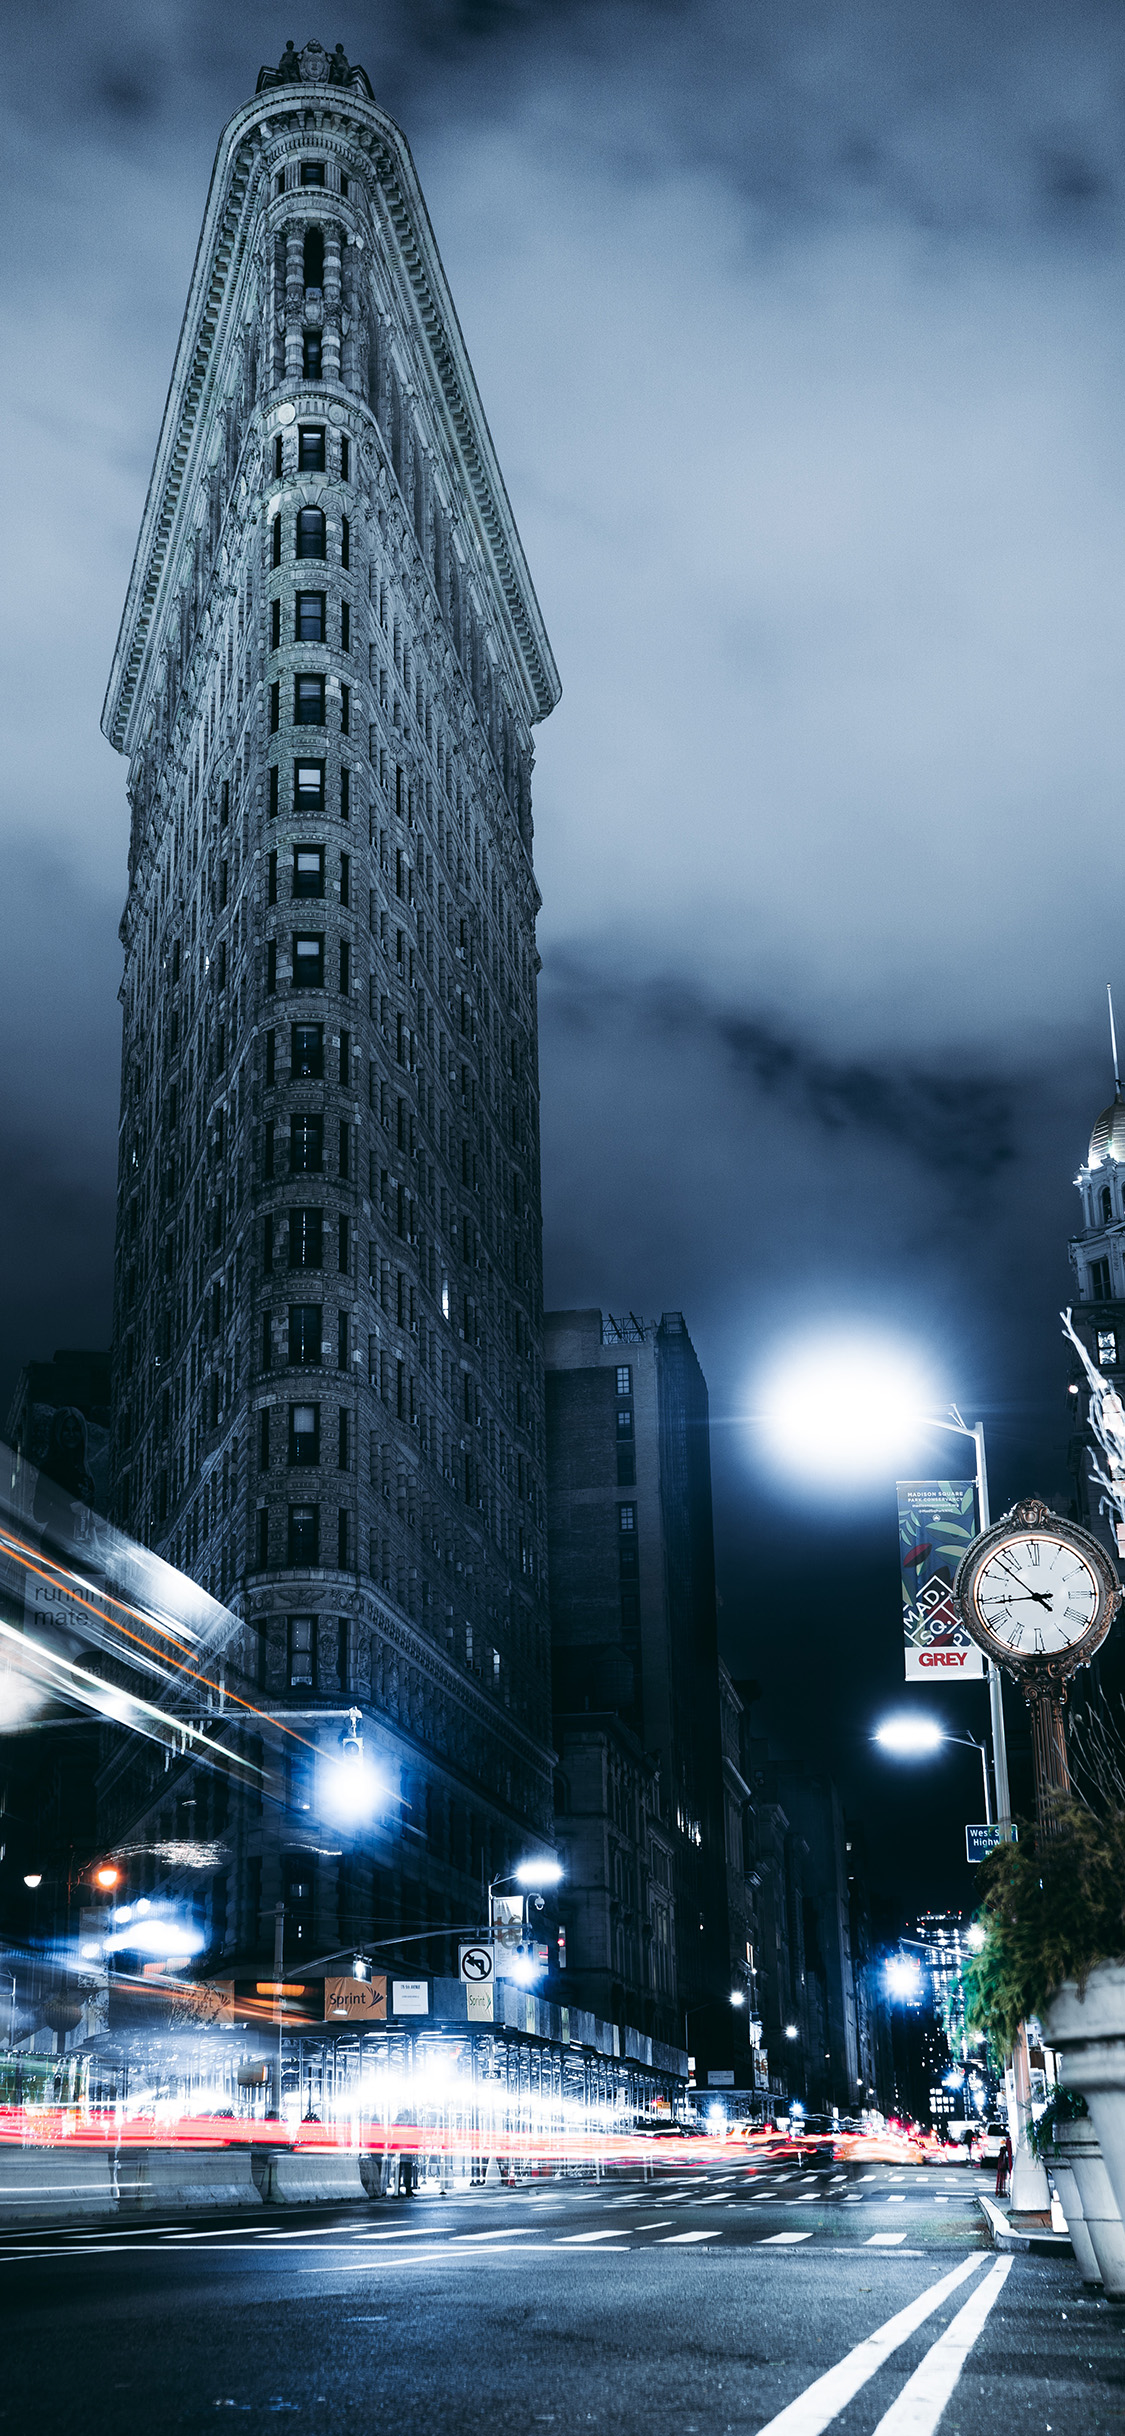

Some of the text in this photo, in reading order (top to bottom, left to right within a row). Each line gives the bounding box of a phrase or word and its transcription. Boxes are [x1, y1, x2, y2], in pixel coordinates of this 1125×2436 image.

[918, 1652, 968, 1667] GREY
[973, 1838, 1001, 1848] Highw
[329, 1993, 366, 2007] Sprint
[469, 1994, 486, 2006] Sprint
